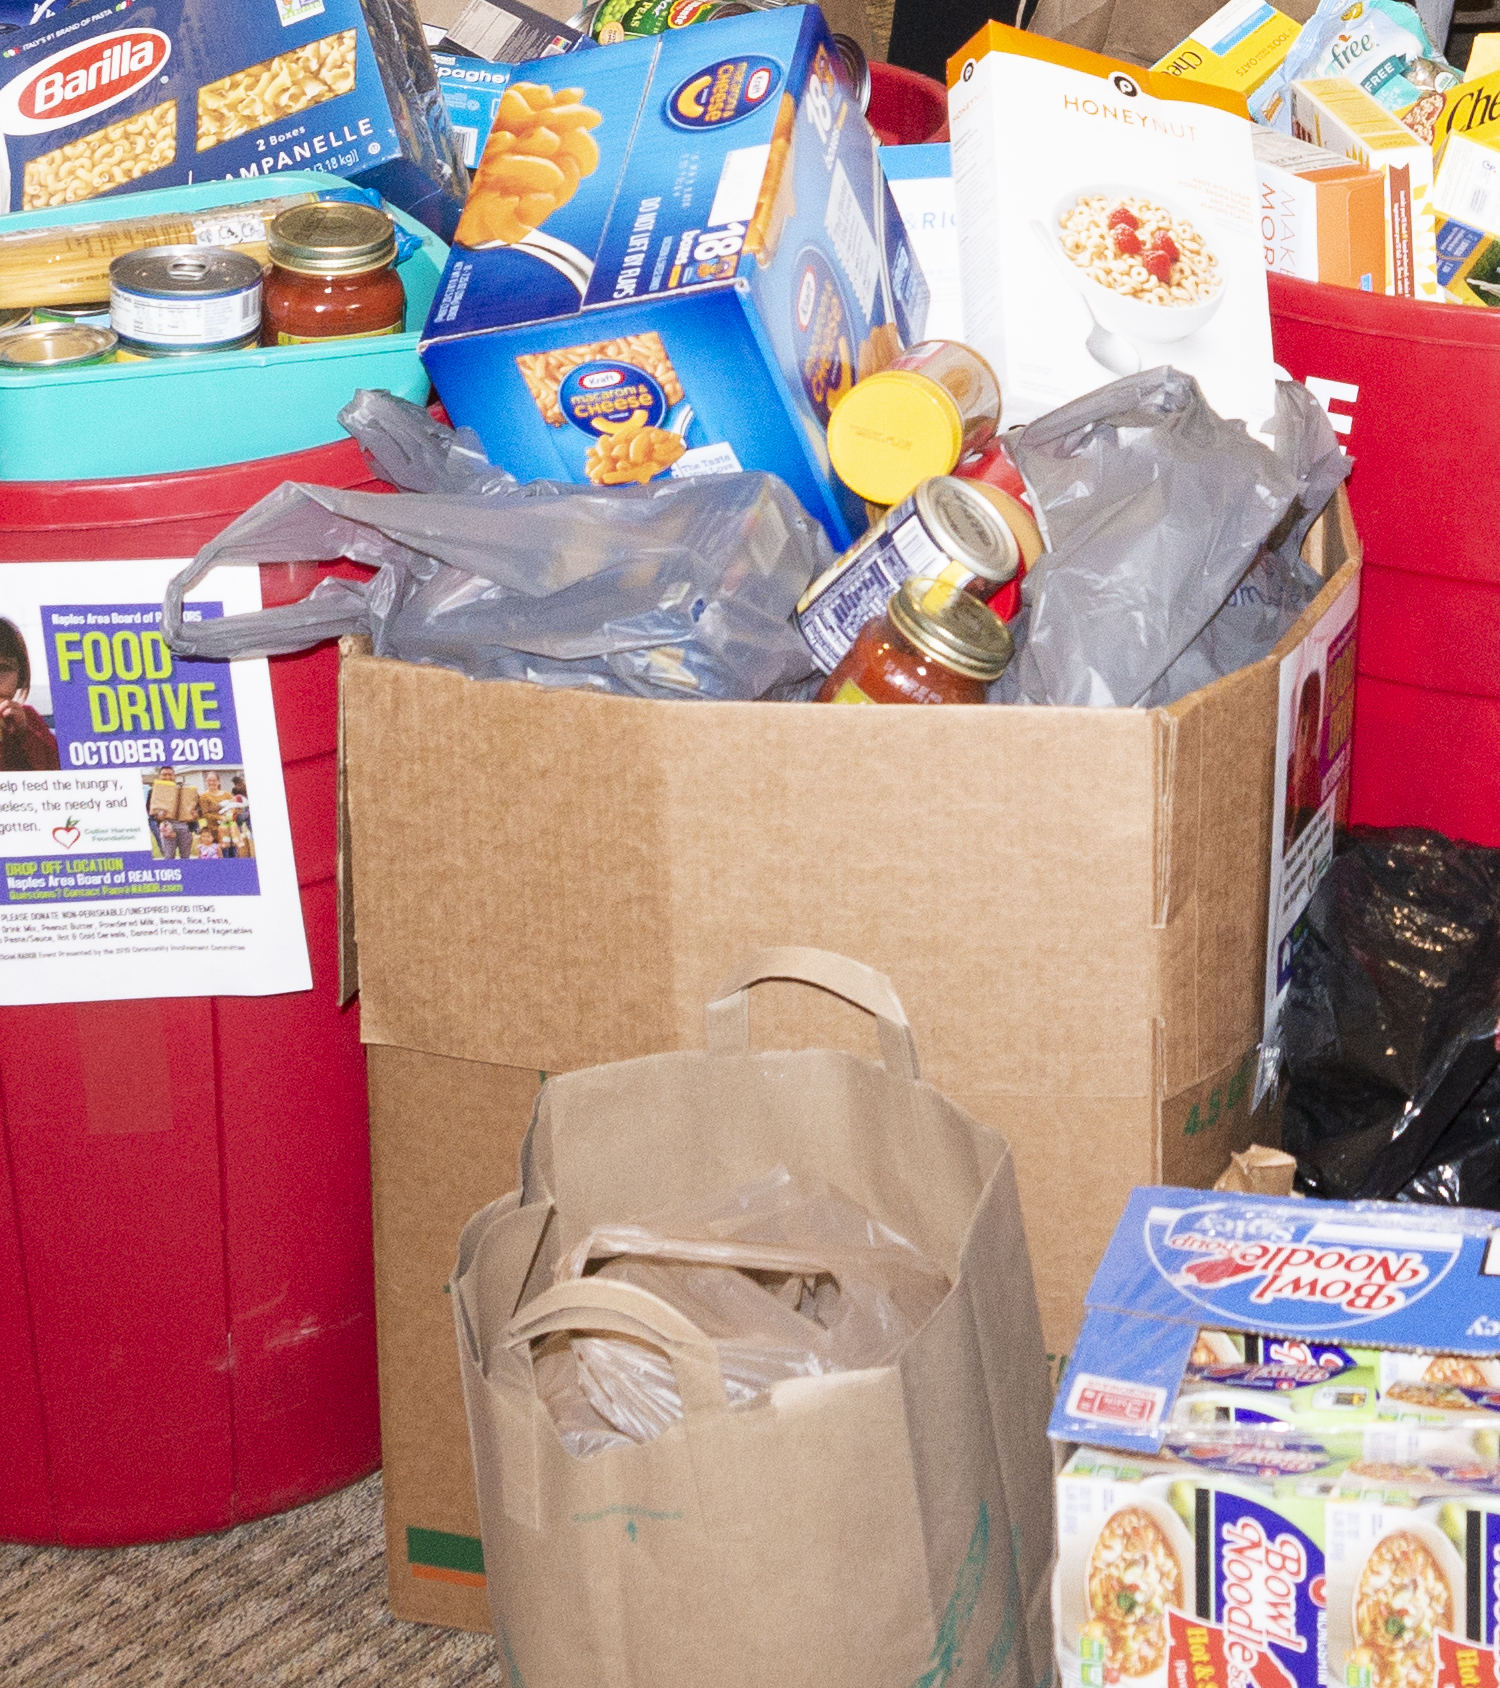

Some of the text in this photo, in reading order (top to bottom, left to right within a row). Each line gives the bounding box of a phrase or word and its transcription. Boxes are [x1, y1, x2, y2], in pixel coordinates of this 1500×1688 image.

[55, 8, 112, 40] BRAND PASTA
[629, 0, 652, 28] PEAS
[34, 40, 154, 114] Barilla
[750, 72, 766, 99] Kraft
[211, 118, 374, 182] AMPANELLE
[256, 125, 306, 151] 2 Boxes
[638, 196, 661, 212] DO
[634, 212, 656, 232] NOT
[628, 233, 650, 254] LIFT
[694, 224, 746, 262] 18
[613, 269, 637, 299] FLAPS
[587, 371, 616, 388] Kraft
[571, 386, 637, 408] macaroni
[52, 611, 154, 627] Naples Area Board of
[54, 631, 174, 682] FOOD
[89, 682, 220, 733] DRIVE
[70, 737, 223, 766] OCTOBER 2019
[22, 779, 48, 792] feed
[52, 779, 72, 791] the
[76, 779, 123, 794] hungry,
[42, 800, 61, 812] the
[65, 800, 101, 814] needy
[105, 798, 128, 810] and
[6, 858, 123, 876] DROP OFF LOCATION
[7, 869, 181, 890] Naples Area Board of REALTORS
[1238, 1240, 1431, 1287] Noodle
[1252, 1270, 1407, 1315] Bowl
[1222, 1516, 1267, 1671] Noodle
[1264, 1532, 1307, 1653] Bowl
